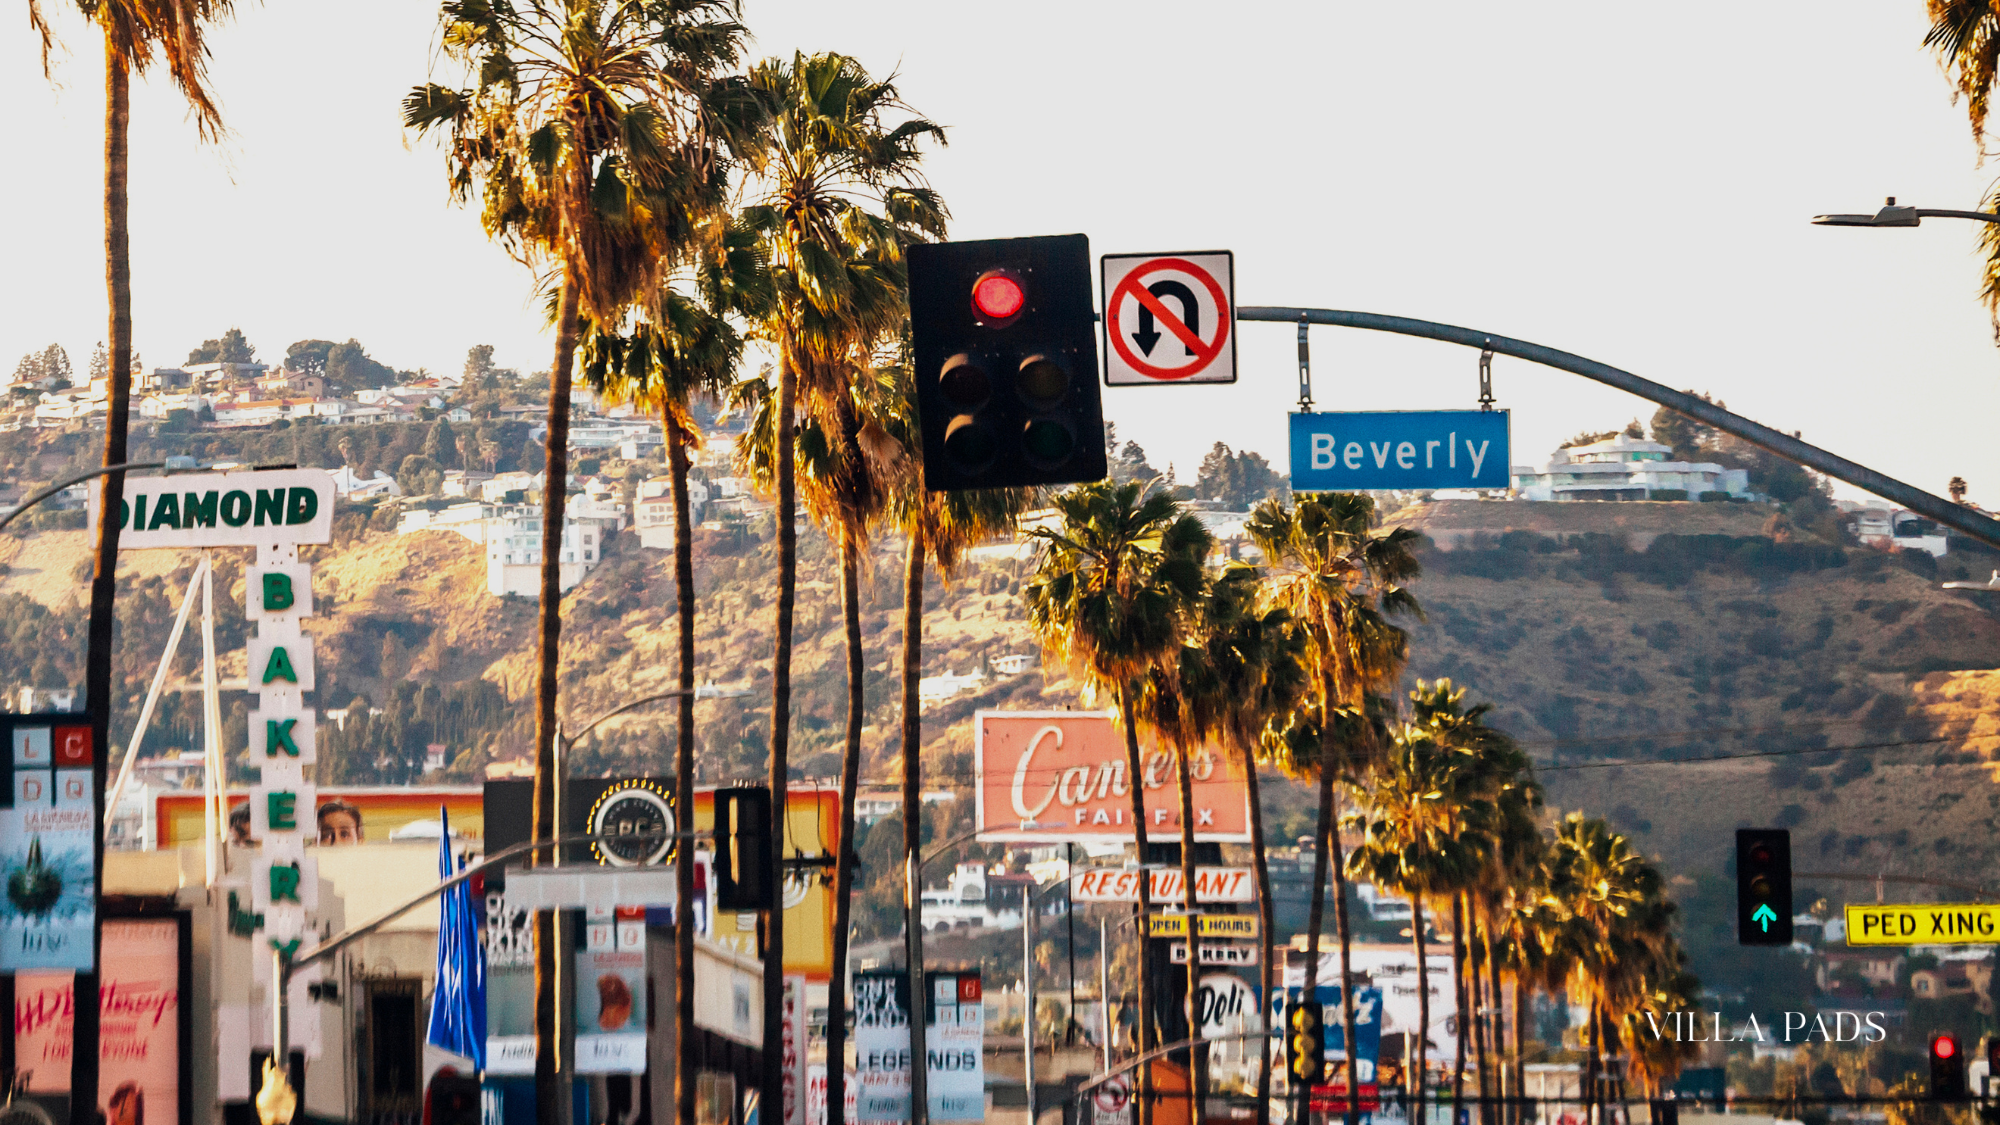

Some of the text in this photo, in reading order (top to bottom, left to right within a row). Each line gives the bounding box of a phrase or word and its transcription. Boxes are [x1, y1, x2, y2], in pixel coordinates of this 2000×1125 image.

[1311, 431, 1490, 479] Beverly
[1075, 807, 1214, 826] FAIFX
[1209, 919, 1252, 933] HOURS
[1863, 912, 1995, 937] PED XING
[1176, 948, 1250, 961] BKERY
[1200, 981, 1245, 1027] Deli
[855, 1049, 976, 1072] LEGENDS
